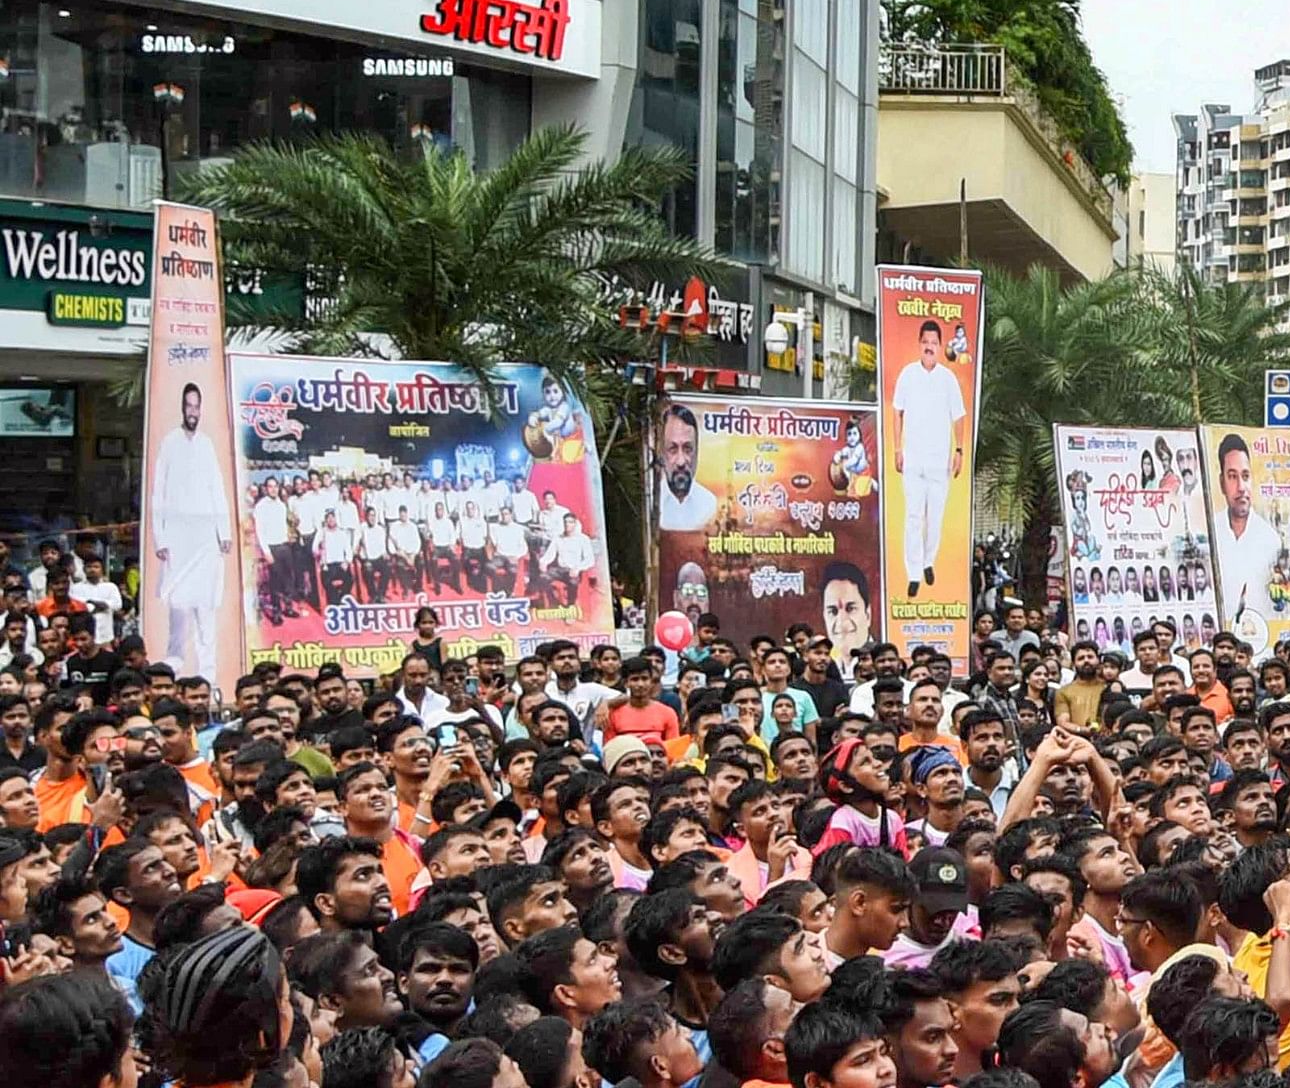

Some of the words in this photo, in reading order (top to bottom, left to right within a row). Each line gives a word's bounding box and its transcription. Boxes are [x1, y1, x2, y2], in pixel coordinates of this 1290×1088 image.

[142, 35, 235, 53] SAMSG
[363, 58, 454, 76] SAMSUNG
[3, 229, 145, 286] Wellness
[55, 294, 124, 322] CHEMISTS
[298, 369, 390, 412] धर्मवीर
[704, 407, 762, 435] धर्मवीर
[767, 411, 840, 439] प्रतिष्ठाण
